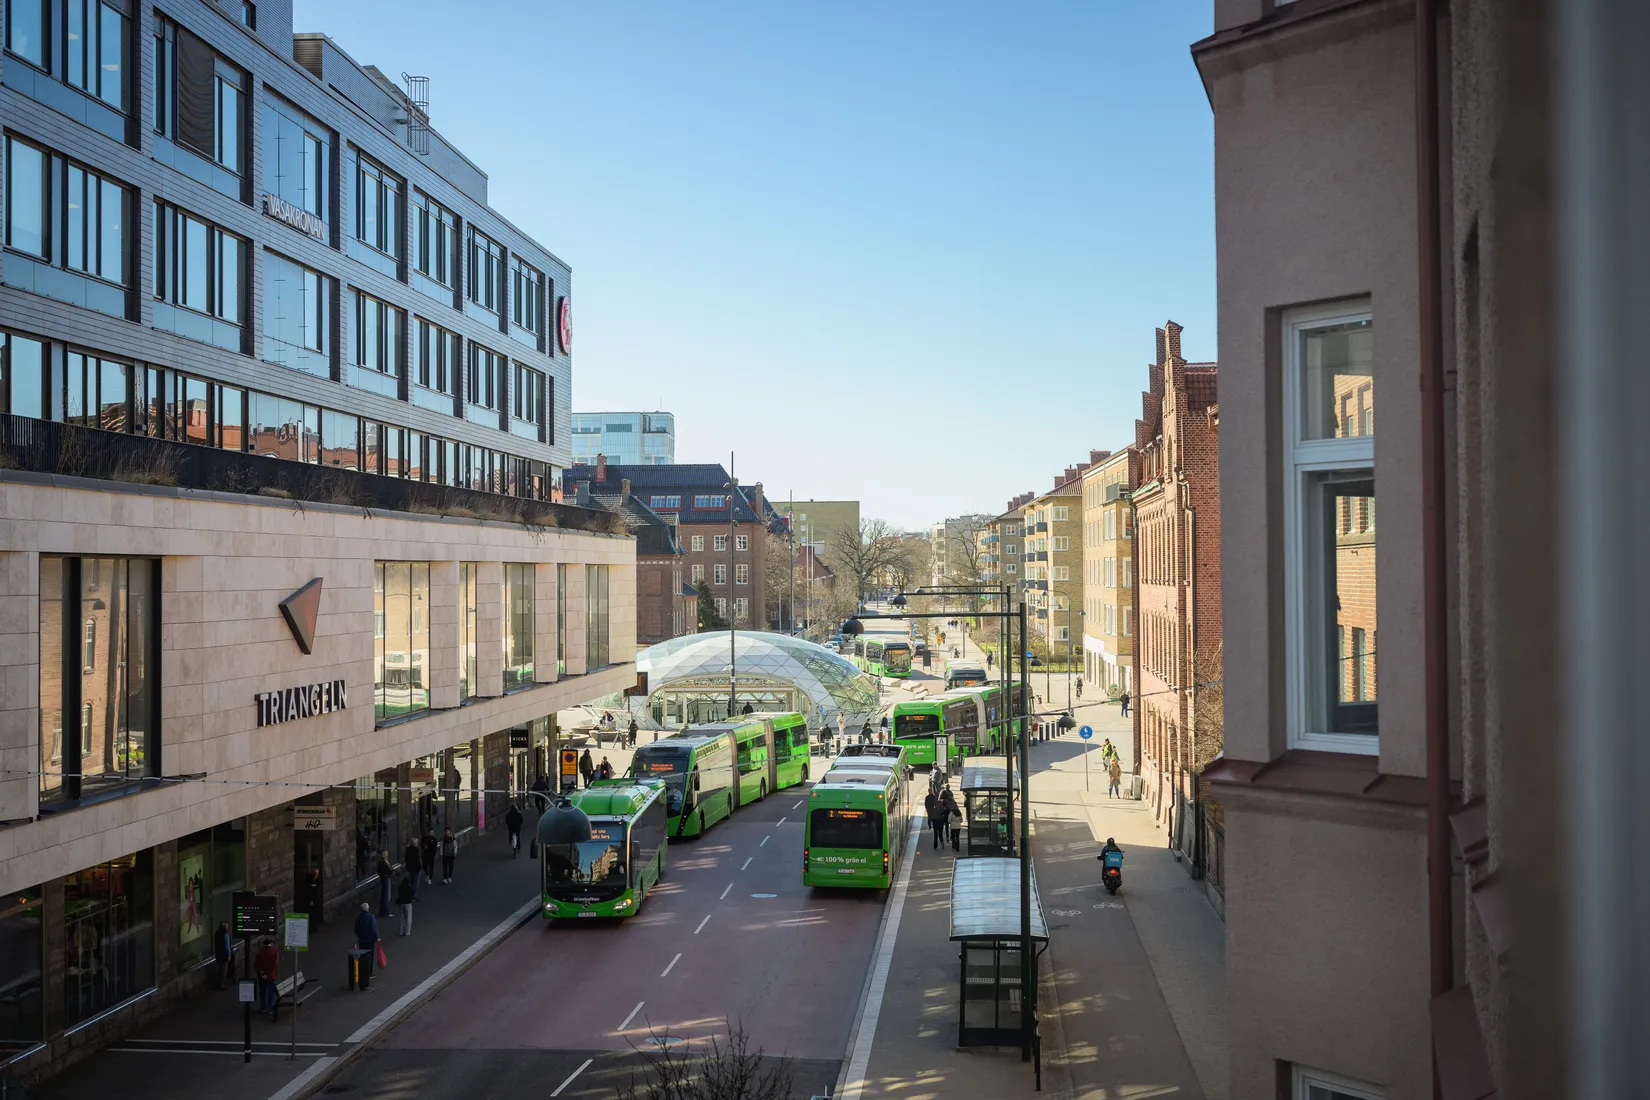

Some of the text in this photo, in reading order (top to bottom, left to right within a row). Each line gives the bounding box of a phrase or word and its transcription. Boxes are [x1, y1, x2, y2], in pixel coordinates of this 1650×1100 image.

[265, 193, 325, 240] VASAKRONAN
[255, 679, 348, 727] TRIANGELN
[829, 810, 834, 818] 2
